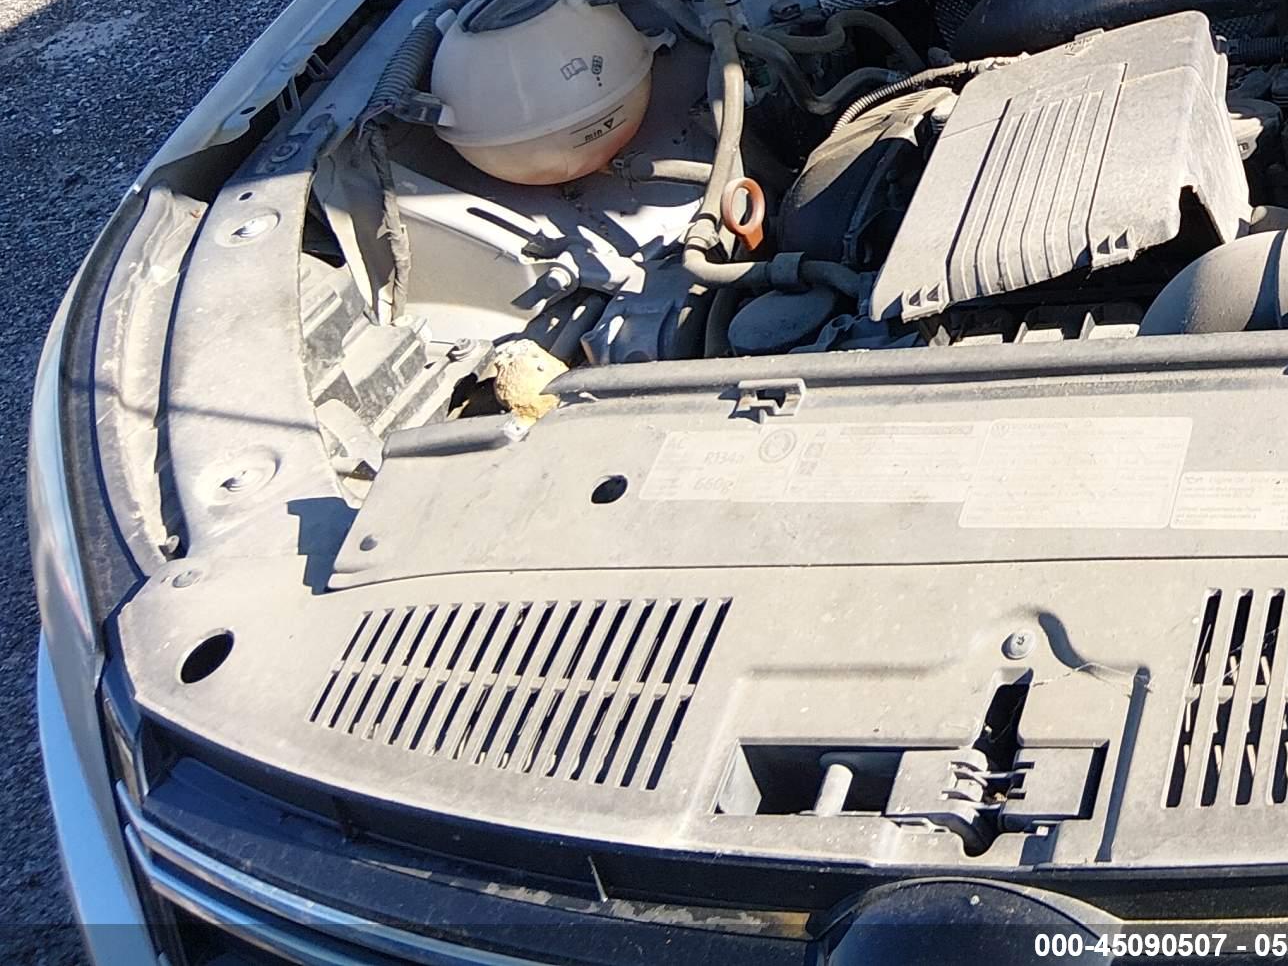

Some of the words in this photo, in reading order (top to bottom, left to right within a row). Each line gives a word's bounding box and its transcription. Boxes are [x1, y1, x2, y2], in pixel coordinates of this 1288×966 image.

[584, 129, 603, 142] min
[666, 436, 689, 450] AC
[703, 451, 745, 466] R134a
[694, 476, 735, 494] 660g
